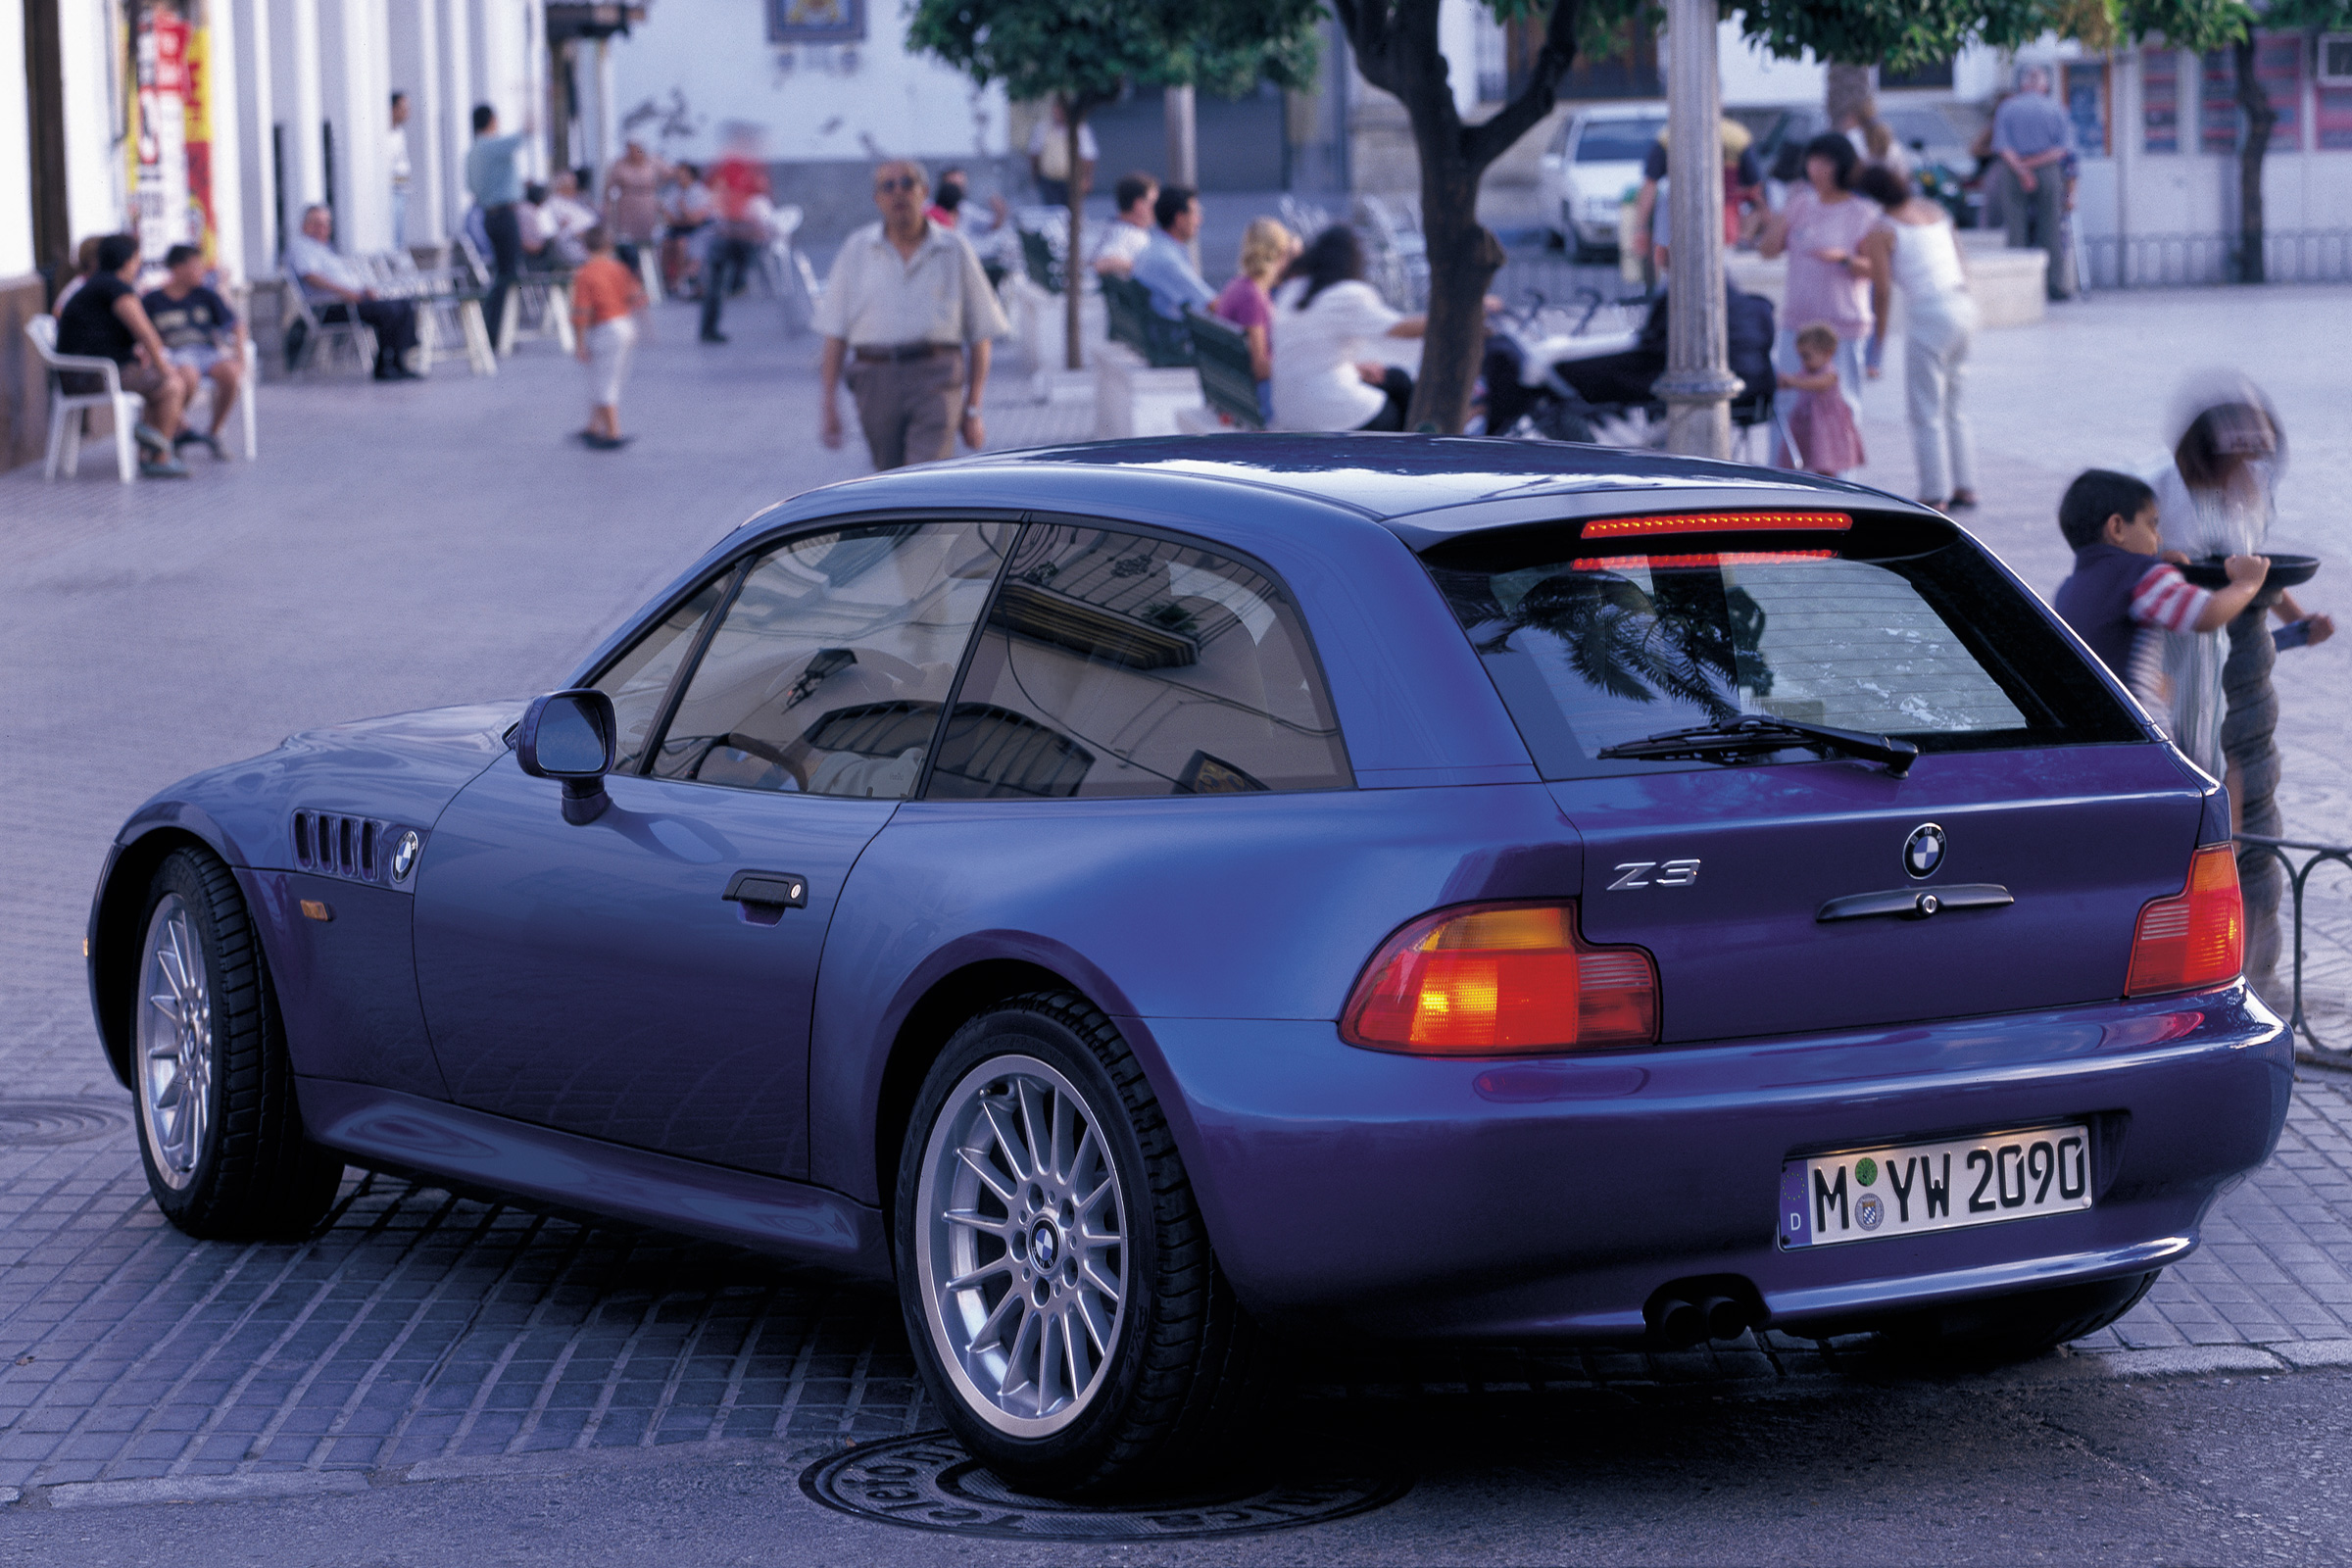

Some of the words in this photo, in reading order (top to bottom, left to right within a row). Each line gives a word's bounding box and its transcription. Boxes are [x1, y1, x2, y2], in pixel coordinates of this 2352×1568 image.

[1606, 858, 1701, 891] Z3
[1814, 1164, 1850, 1232] M
[1886, 1151, 1951, 1223] YW
[1967, 1137, 2086, 1213] 2090
[1790, 1212, 1801, 1232] D
